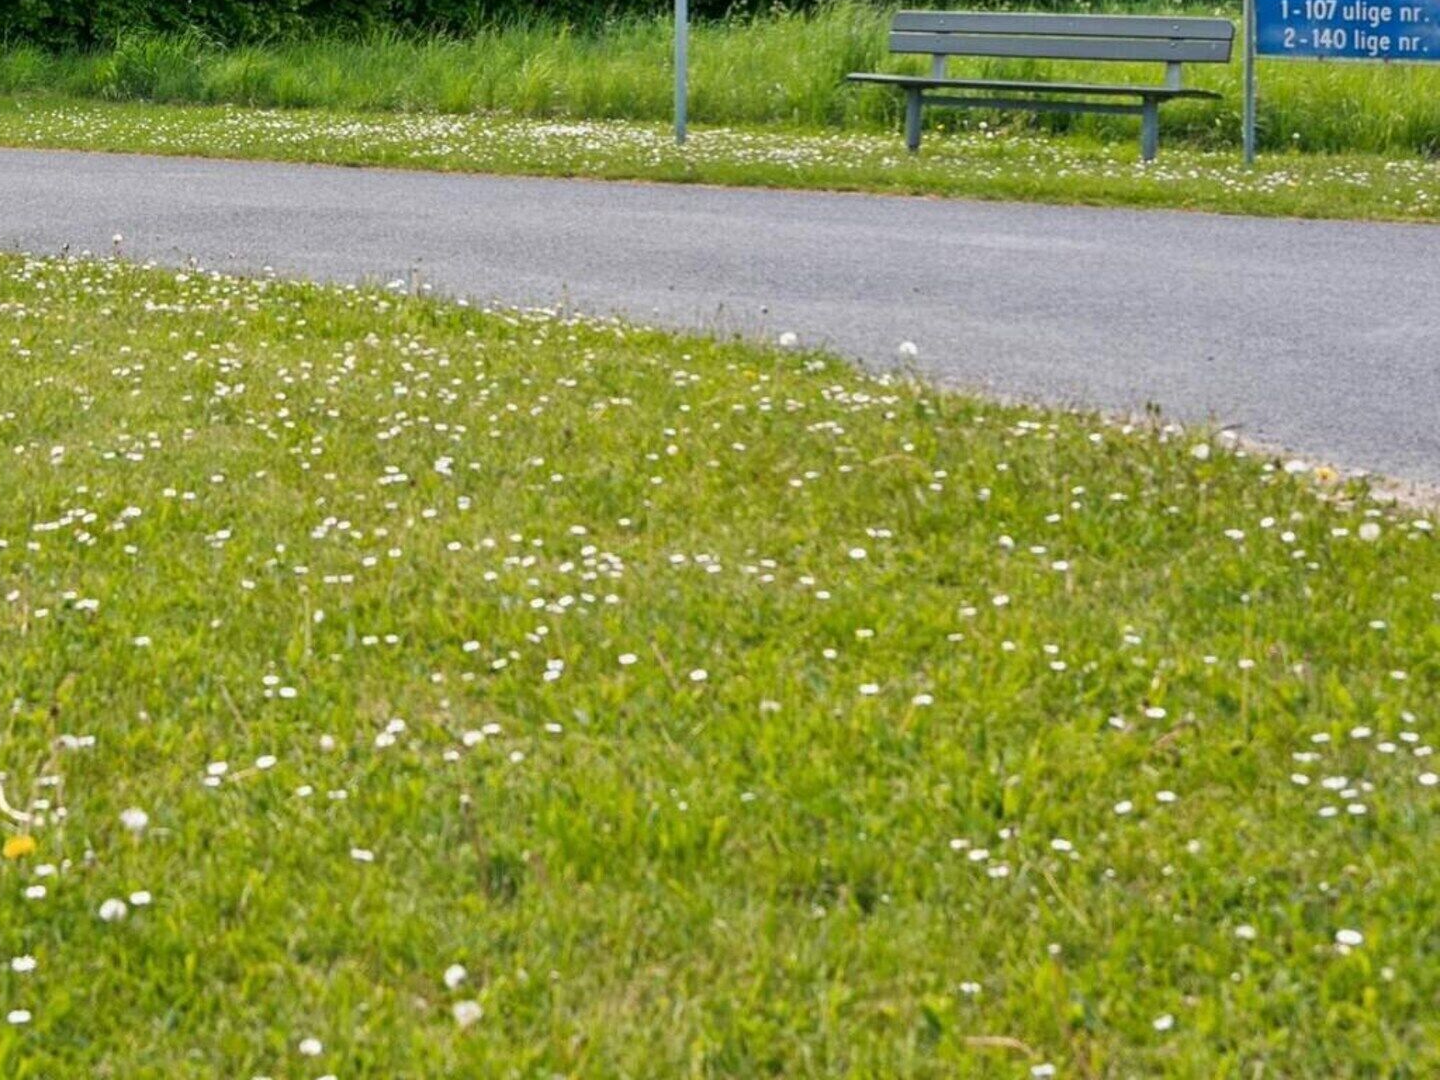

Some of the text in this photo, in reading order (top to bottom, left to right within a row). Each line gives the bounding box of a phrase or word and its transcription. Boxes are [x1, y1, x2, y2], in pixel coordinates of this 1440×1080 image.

[1342, 0, 1392, 27] ulige
[1399, 6, 1430, 22] nr.
[1353, 29, 1391, 56] lige
[1398, 38, 1429, 52] nr.
